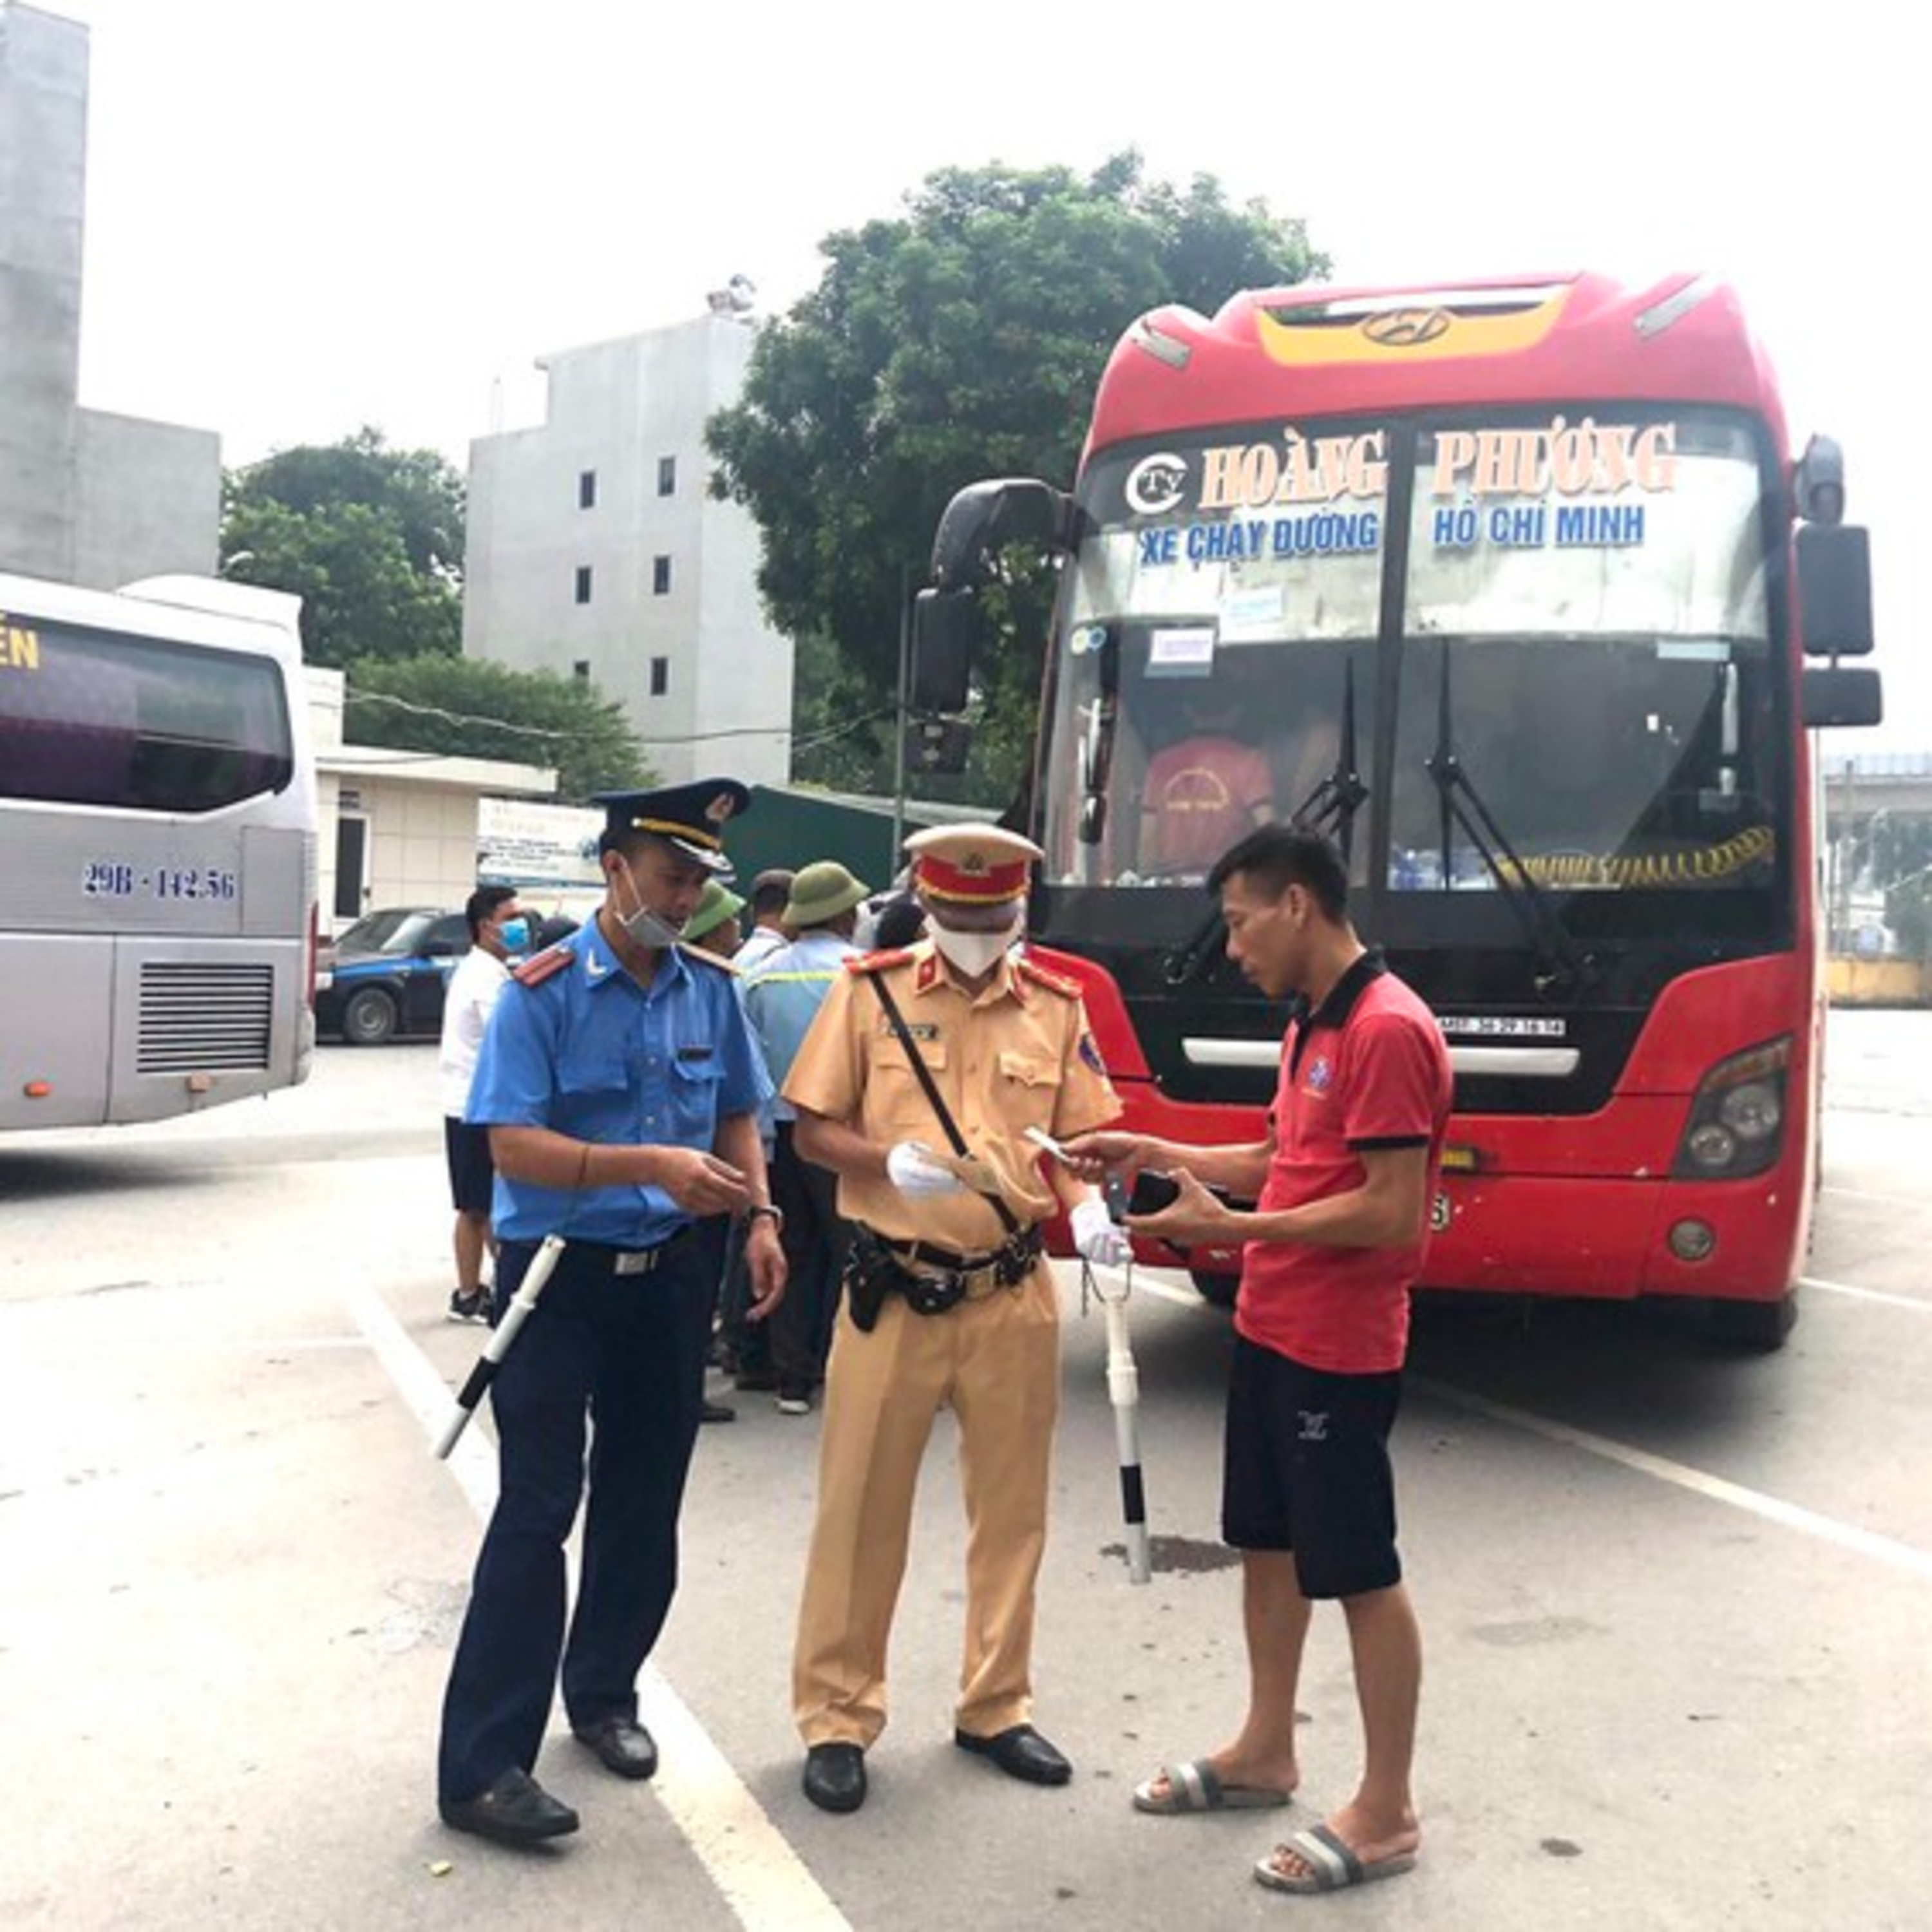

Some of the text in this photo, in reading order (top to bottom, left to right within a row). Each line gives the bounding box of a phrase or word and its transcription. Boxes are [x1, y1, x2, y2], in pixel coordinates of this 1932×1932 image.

[1198, 424, 1389, 508] HOÀNG
[1141, 527, 1177, 565] XE
[1556, 504, 1644, 543] MINH
